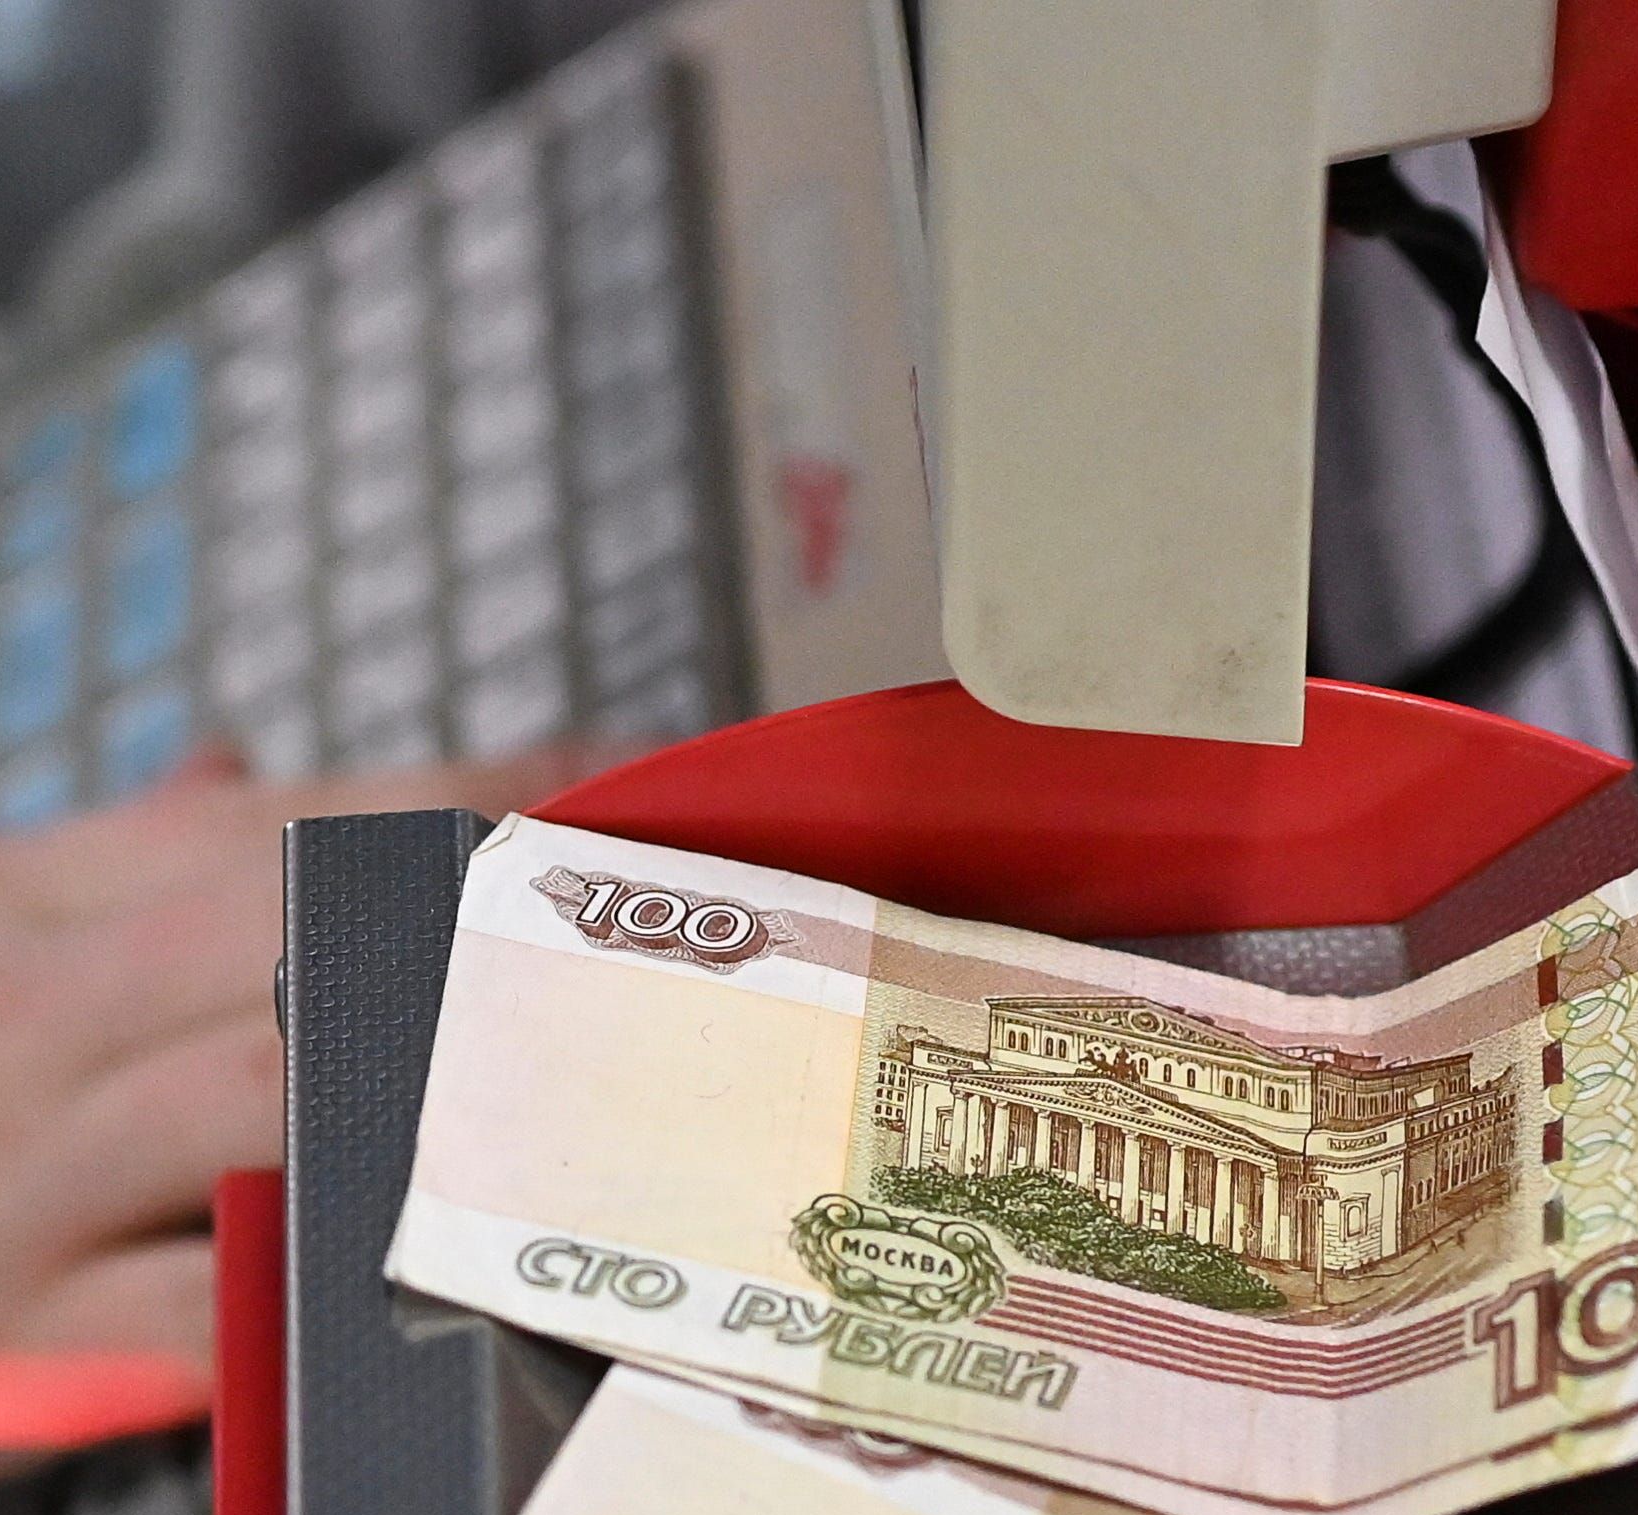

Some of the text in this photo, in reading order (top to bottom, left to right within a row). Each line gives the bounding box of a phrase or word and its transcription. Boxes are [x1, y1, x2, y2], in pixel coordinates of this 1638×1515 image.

[575, 878, 767, 956] 100
[840, 1235, 955, 1279] МОСКВА
[514, 1236, 1081, 1411] СТО РУБЛЕЙ
